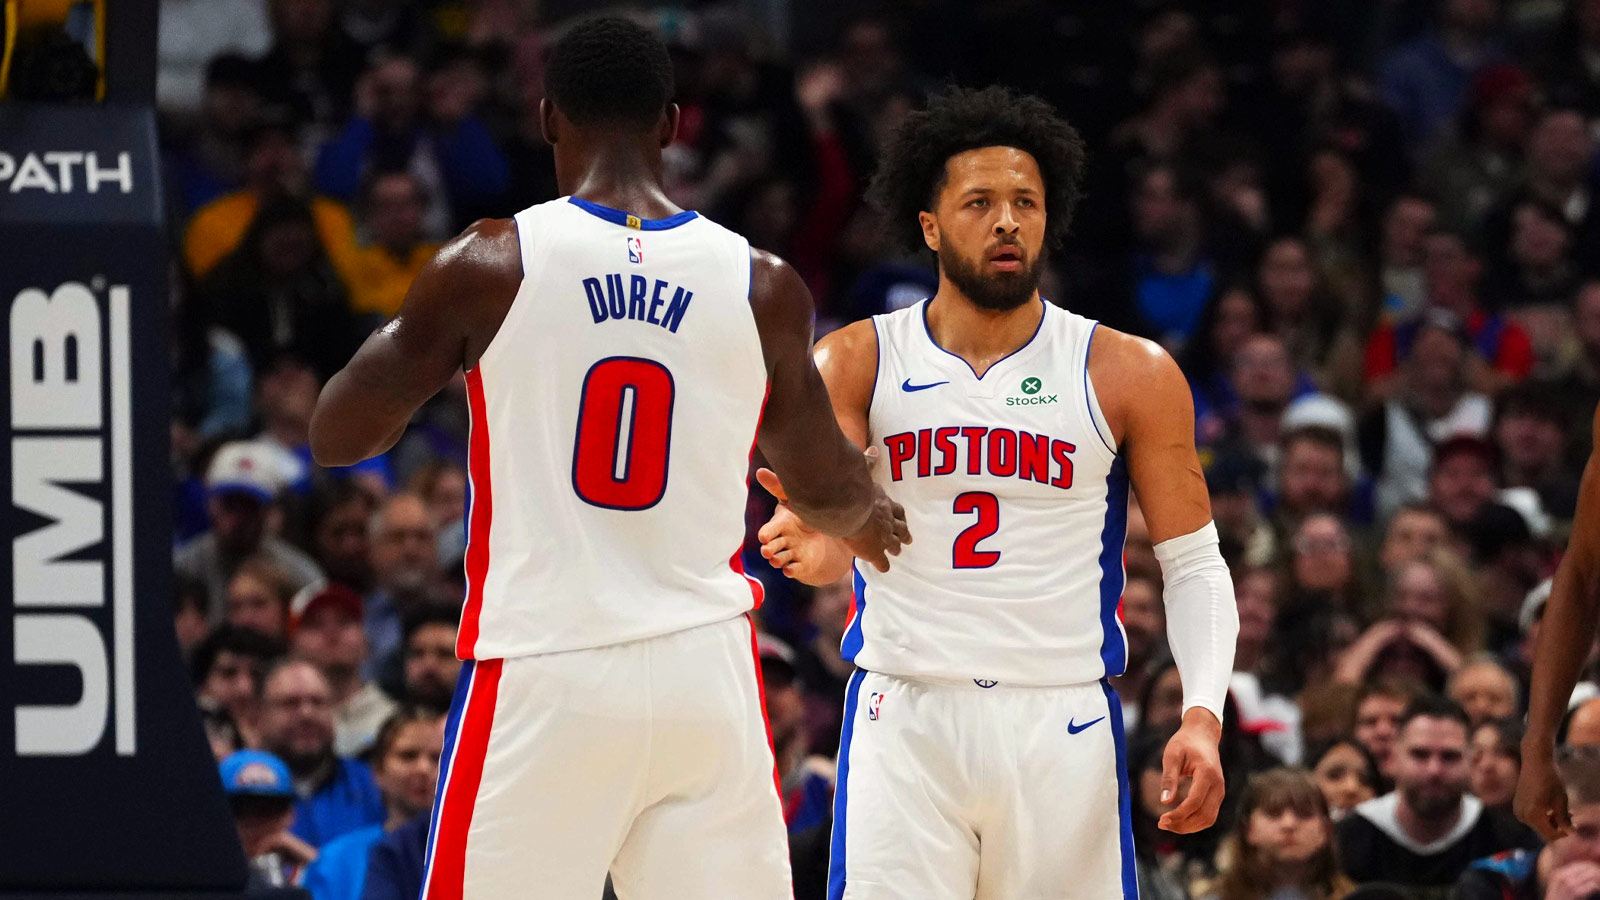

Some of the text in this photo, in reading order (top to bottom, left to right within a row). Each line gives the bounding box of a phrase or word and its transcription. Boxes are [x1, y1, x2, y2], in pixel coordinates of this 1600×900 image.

[582, 273, 694, 334] DUREN
[571, 355, 676, 512] 0
[1005, 394, 1058, 406] StockX
[883, 426, 1077, 490] PISTONS
[9, 280, 110, 757] UMB
[952, 490, 1001, 569] 2
